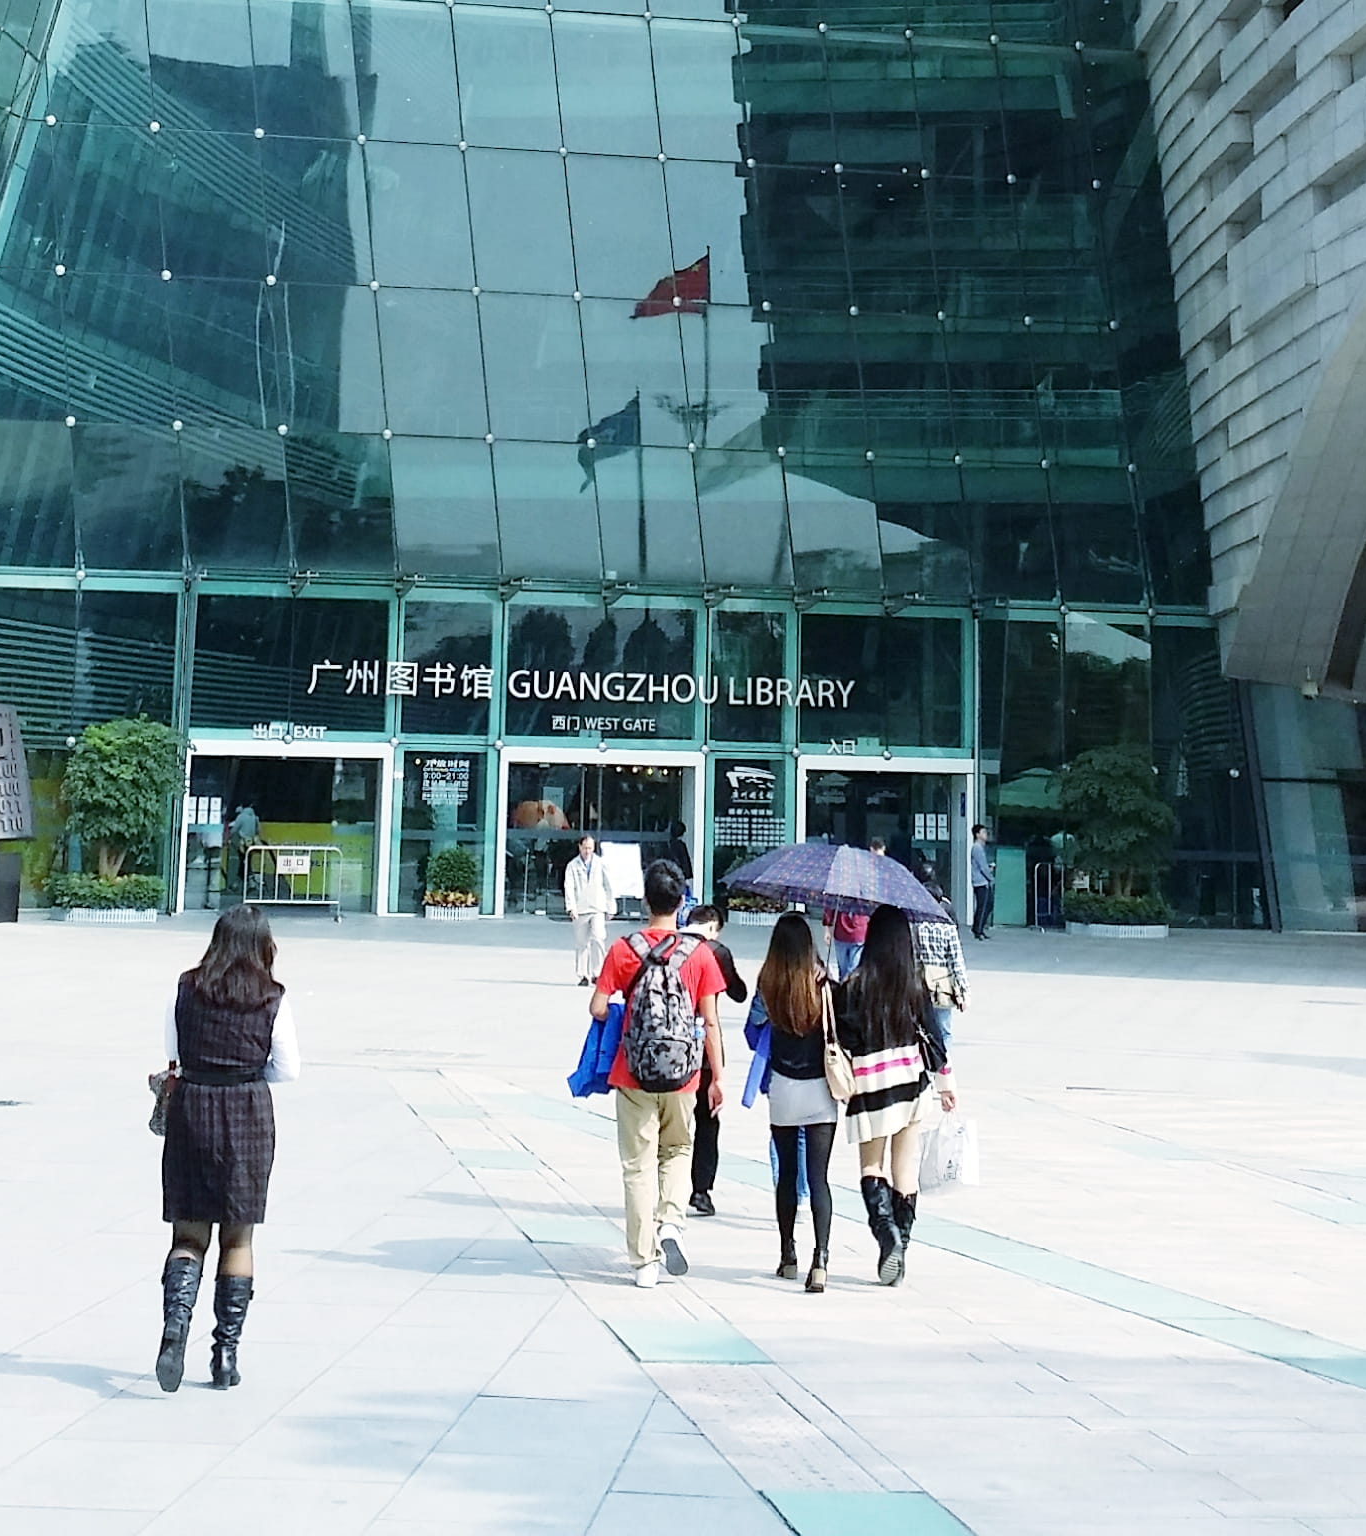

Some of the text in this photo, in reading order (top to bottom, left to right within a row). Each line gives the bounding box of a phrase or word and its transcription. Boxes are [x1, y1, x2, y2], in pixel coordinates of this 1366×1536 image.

[307, 659, 495, 700] 广州图书馆
[507, 669, 856, 709] GUANGZHOU LIBRARY
[252, 722, 283, 740] 出口
[551, 715, 581, 731] 西门
[584, 716, 656, 732] WEST GATE
[294, 725, 327, 739] EXIT
[827, 738, 855, 754] 入口
